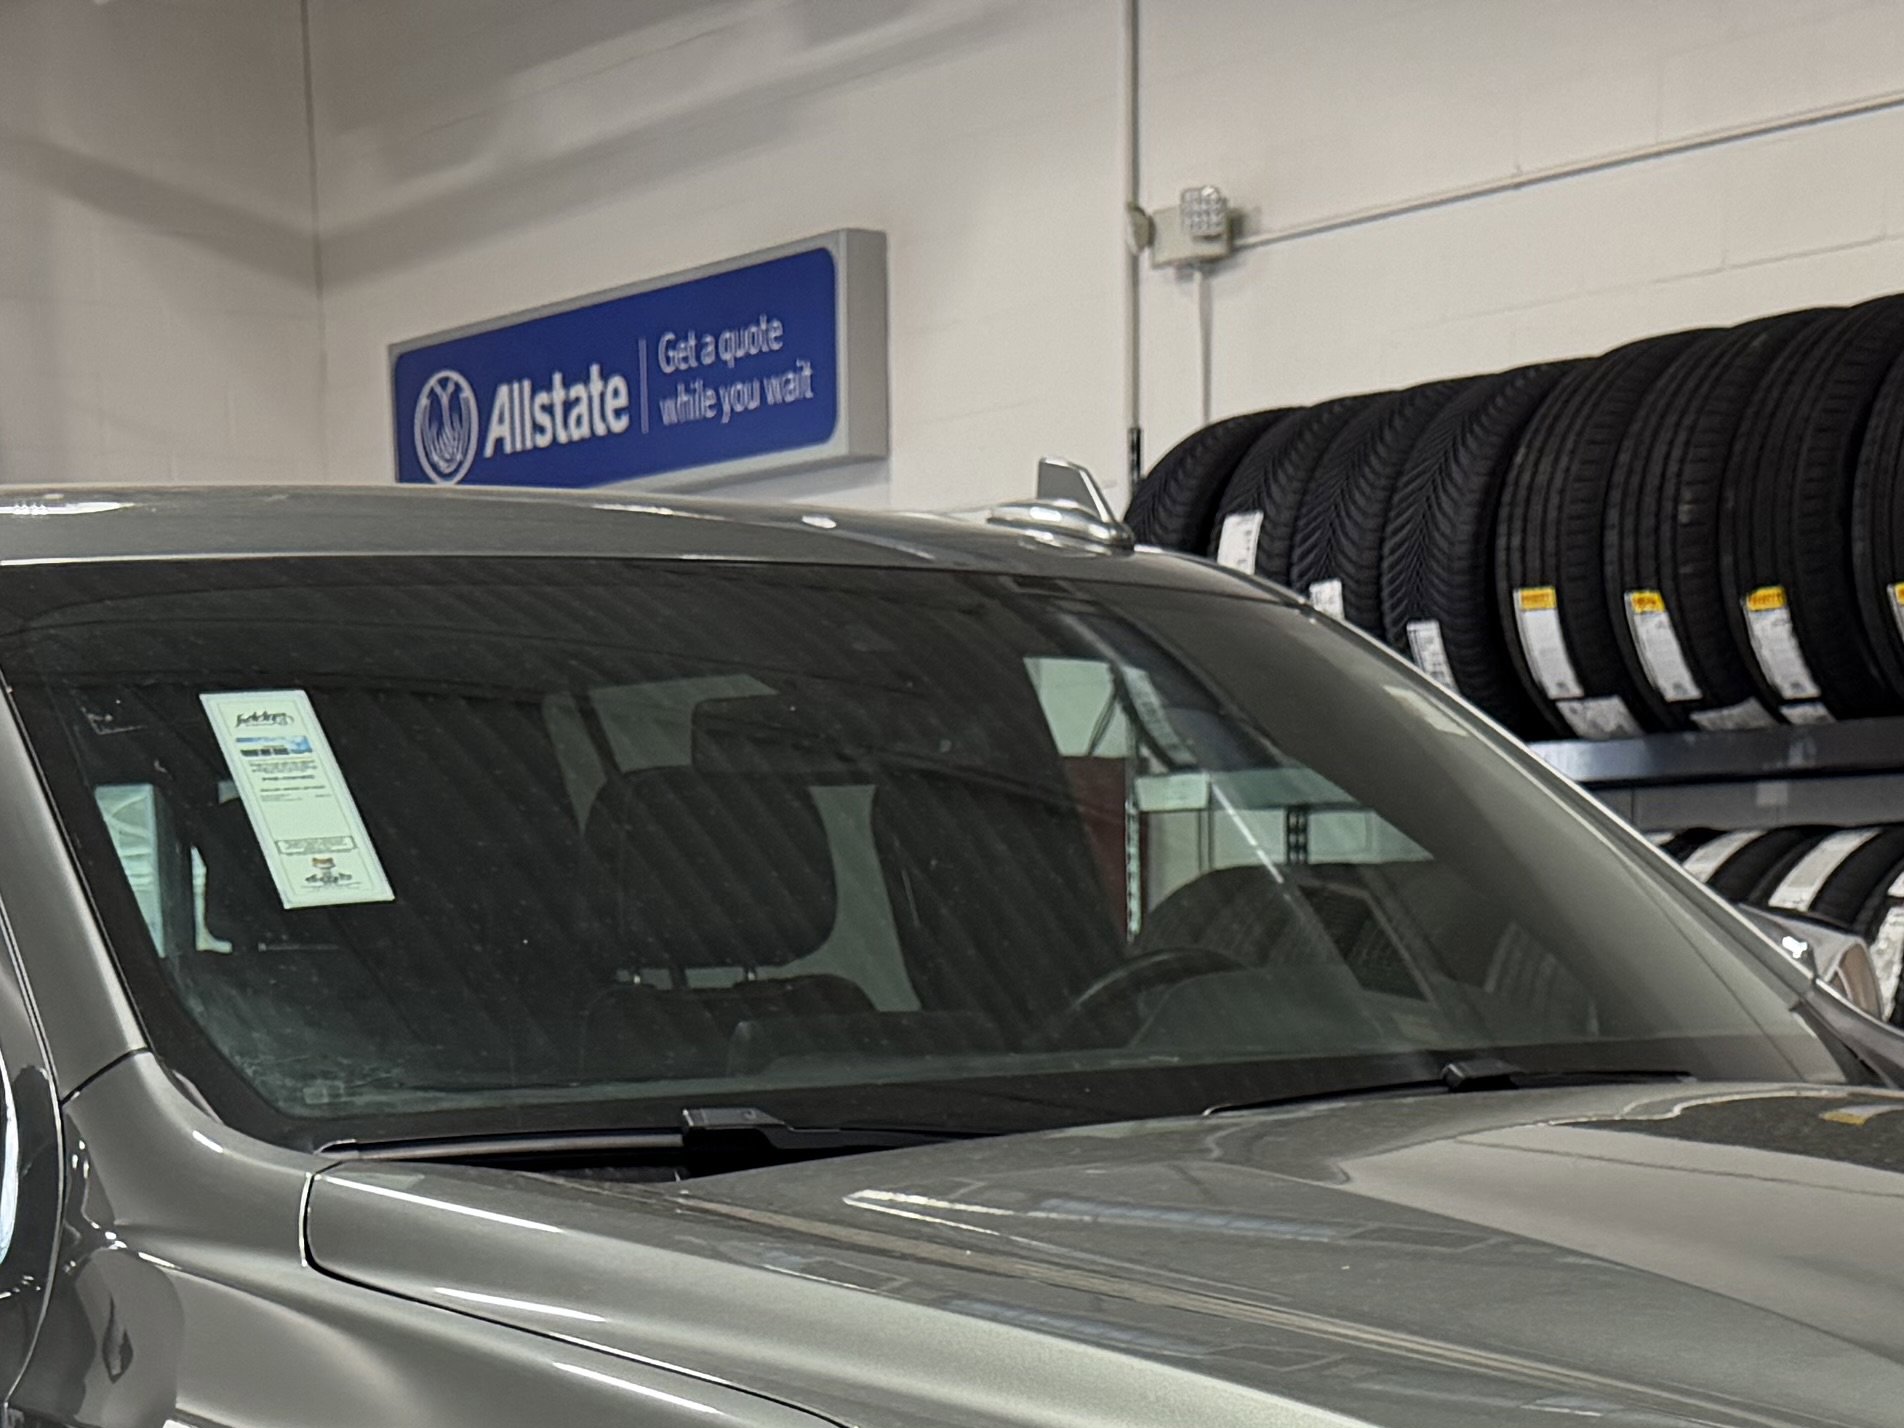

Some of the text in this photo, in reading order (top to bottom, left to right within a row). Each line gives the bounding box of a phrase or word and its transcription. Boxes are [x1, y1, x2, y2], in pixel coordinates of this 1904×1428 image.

[657, 314, 784, 373] Get a quote
[482, 363, 630, 458] Allstate
[658, 358, 814, 426] while you wait
